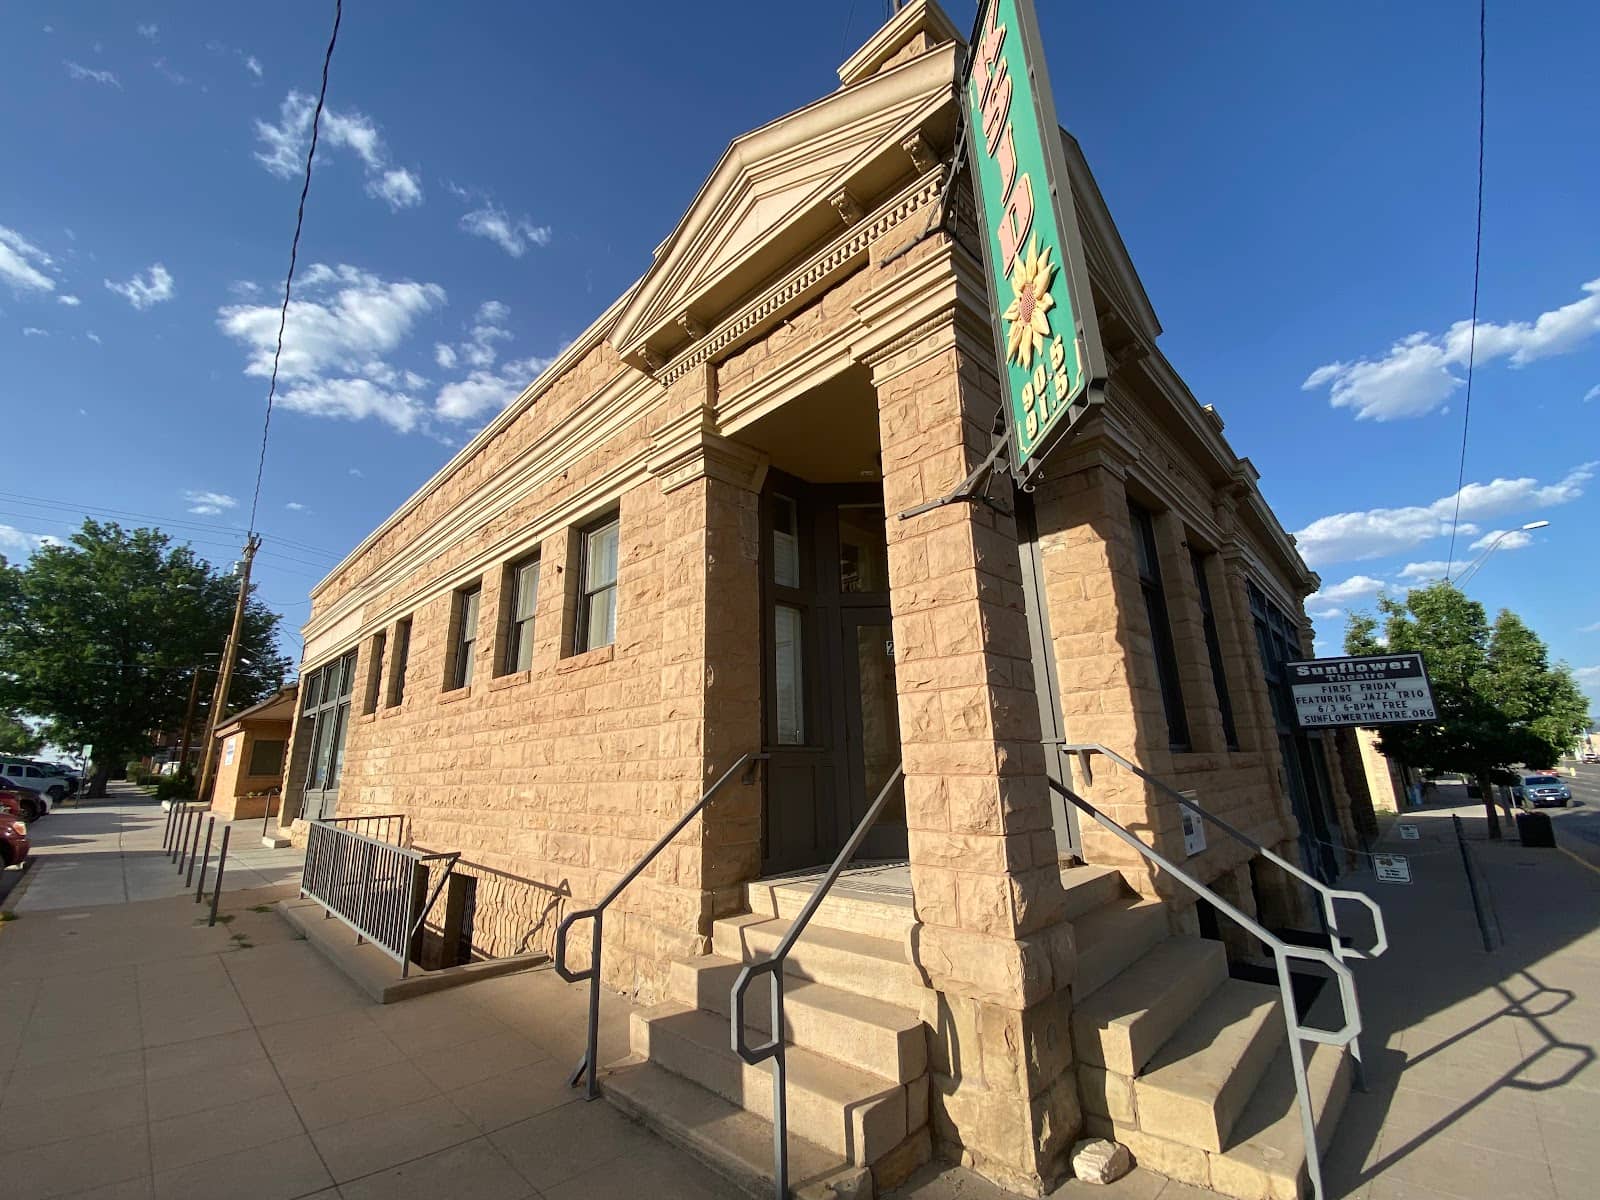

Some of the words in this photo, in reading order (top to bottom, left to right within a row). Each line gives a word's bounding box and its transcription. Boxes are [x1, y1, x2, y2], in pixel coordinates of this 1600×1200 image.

[973, 0, 1035, 280] KSJD
[1021, 334, 1065, 413] 90.5
[1025, 364, 1069, 440] 91.5
[1296, 660, 1412, 677] Sunflower
[1326, 672, 1385, 682] Theatre
[1321, 684, 1353, 694] FIRST
[1360, 681, 1398, 692] FRIDAY
[1296, 694, 1353, 705] FEATURING
[1362, 691, 1389, 701] JAZZ
[1398, 689, 1424, 699] TRIO
[1318, 704, 1337, 713] 6/3
[1343, 702, 1375, 712] 6-8PM
[1383, 700, 1409, 709] FREE
[1304, 709, 1434, 724] SUNFLOWERTHEATRE.ORG
